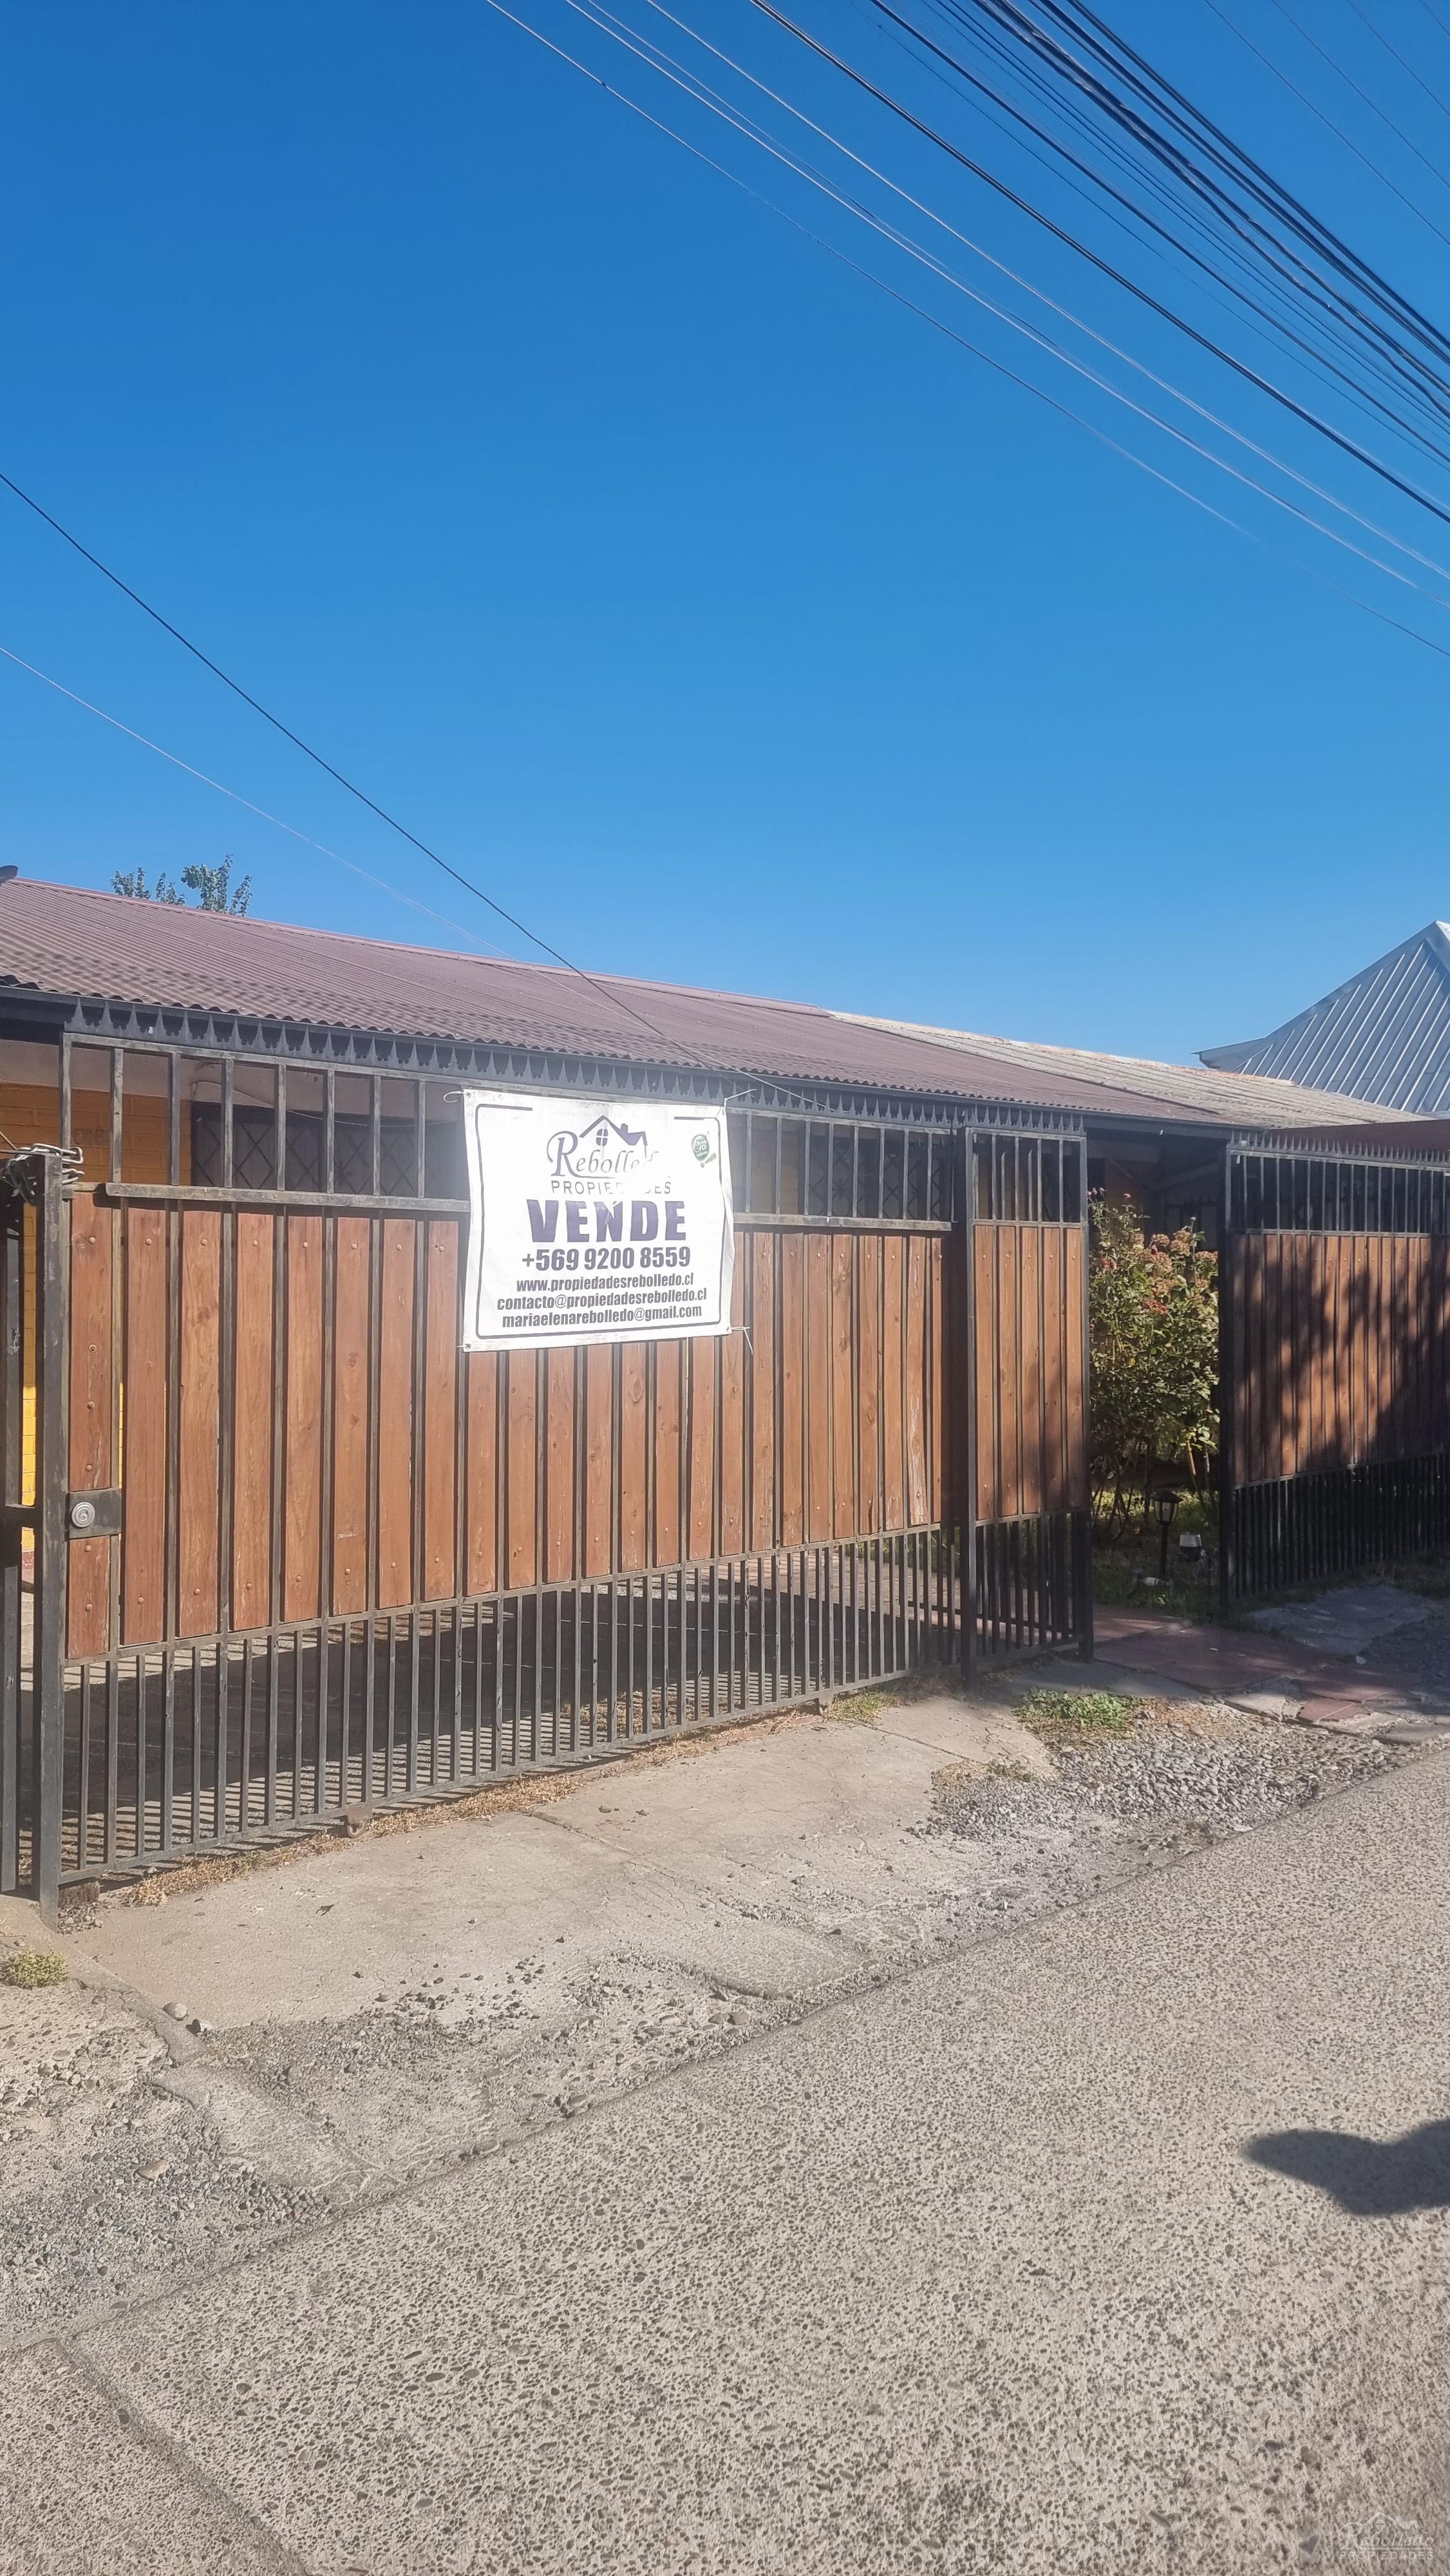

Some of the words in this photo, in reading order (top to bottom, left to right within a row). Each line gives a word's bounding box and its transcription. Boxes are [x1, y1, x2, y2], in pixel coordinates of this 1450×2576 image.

[547, 1130, 659, 1178] Rebolled
[551, 1180, 672, 1195] PROPIEES
[526, 1198, 686, 1243] VENDE
[522, 1248, 579, 1271] +569
[584, 1247, 635, 1271] 9200
[639, 1245, 691, 1269] 8559
[516, 1272, 694, 1293] www.propiedadesrebolledo.cl
[497, 1287, 707, 1311] contacto@propiedadesrebolledo.cl
[502, 1305, 702, 1328] mariaelenarebolledo@gmail.com
